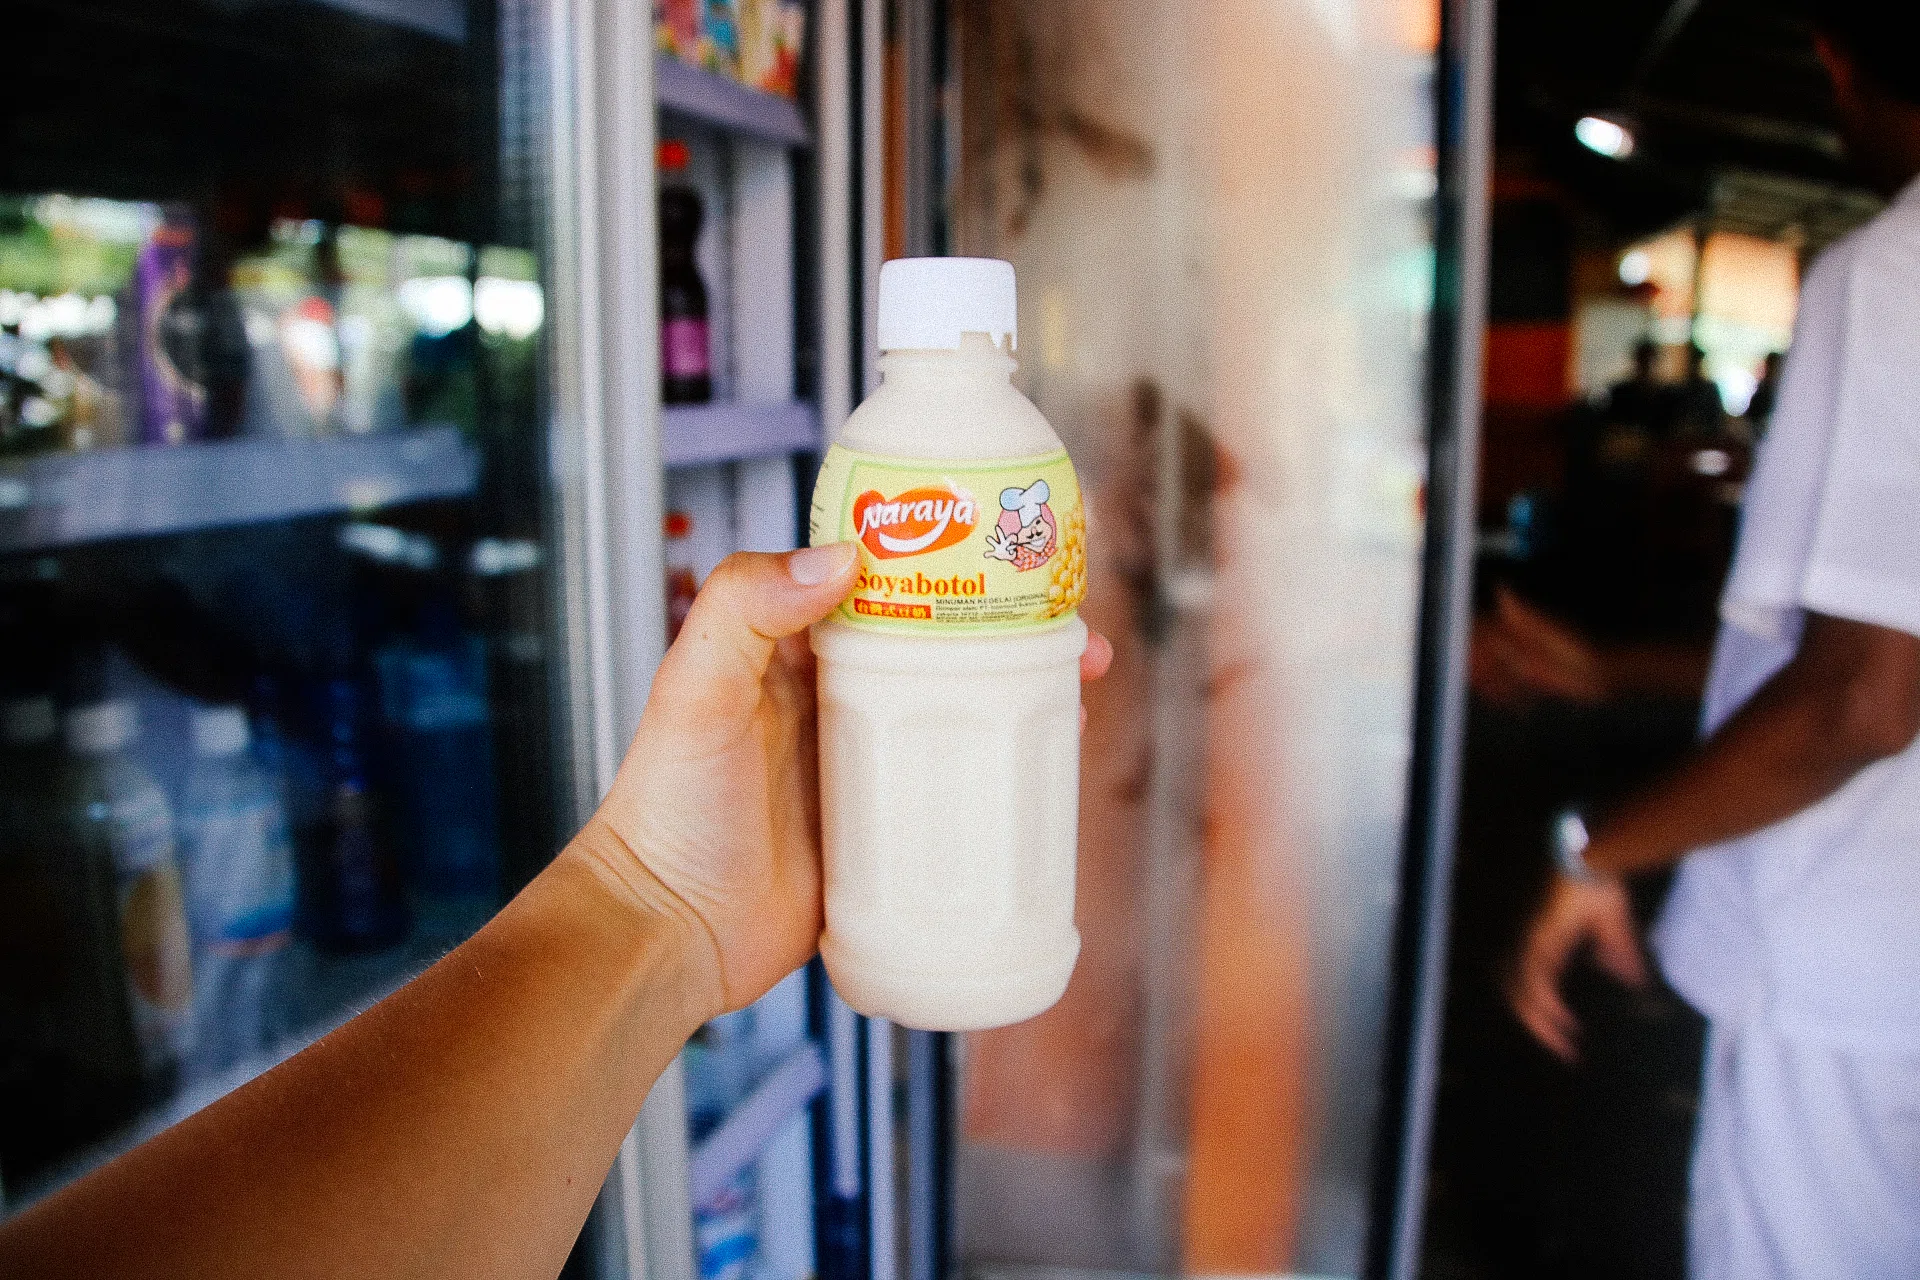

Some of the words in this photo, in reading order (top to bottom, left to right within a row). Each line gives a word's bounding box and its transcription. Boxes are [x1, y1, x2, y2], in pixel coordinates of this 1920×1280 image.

[858, 497, 975, 552] Naraya
[855, 565, 986, 599] Soyabotol
[935, 598, 976, 606] MINUMAN
